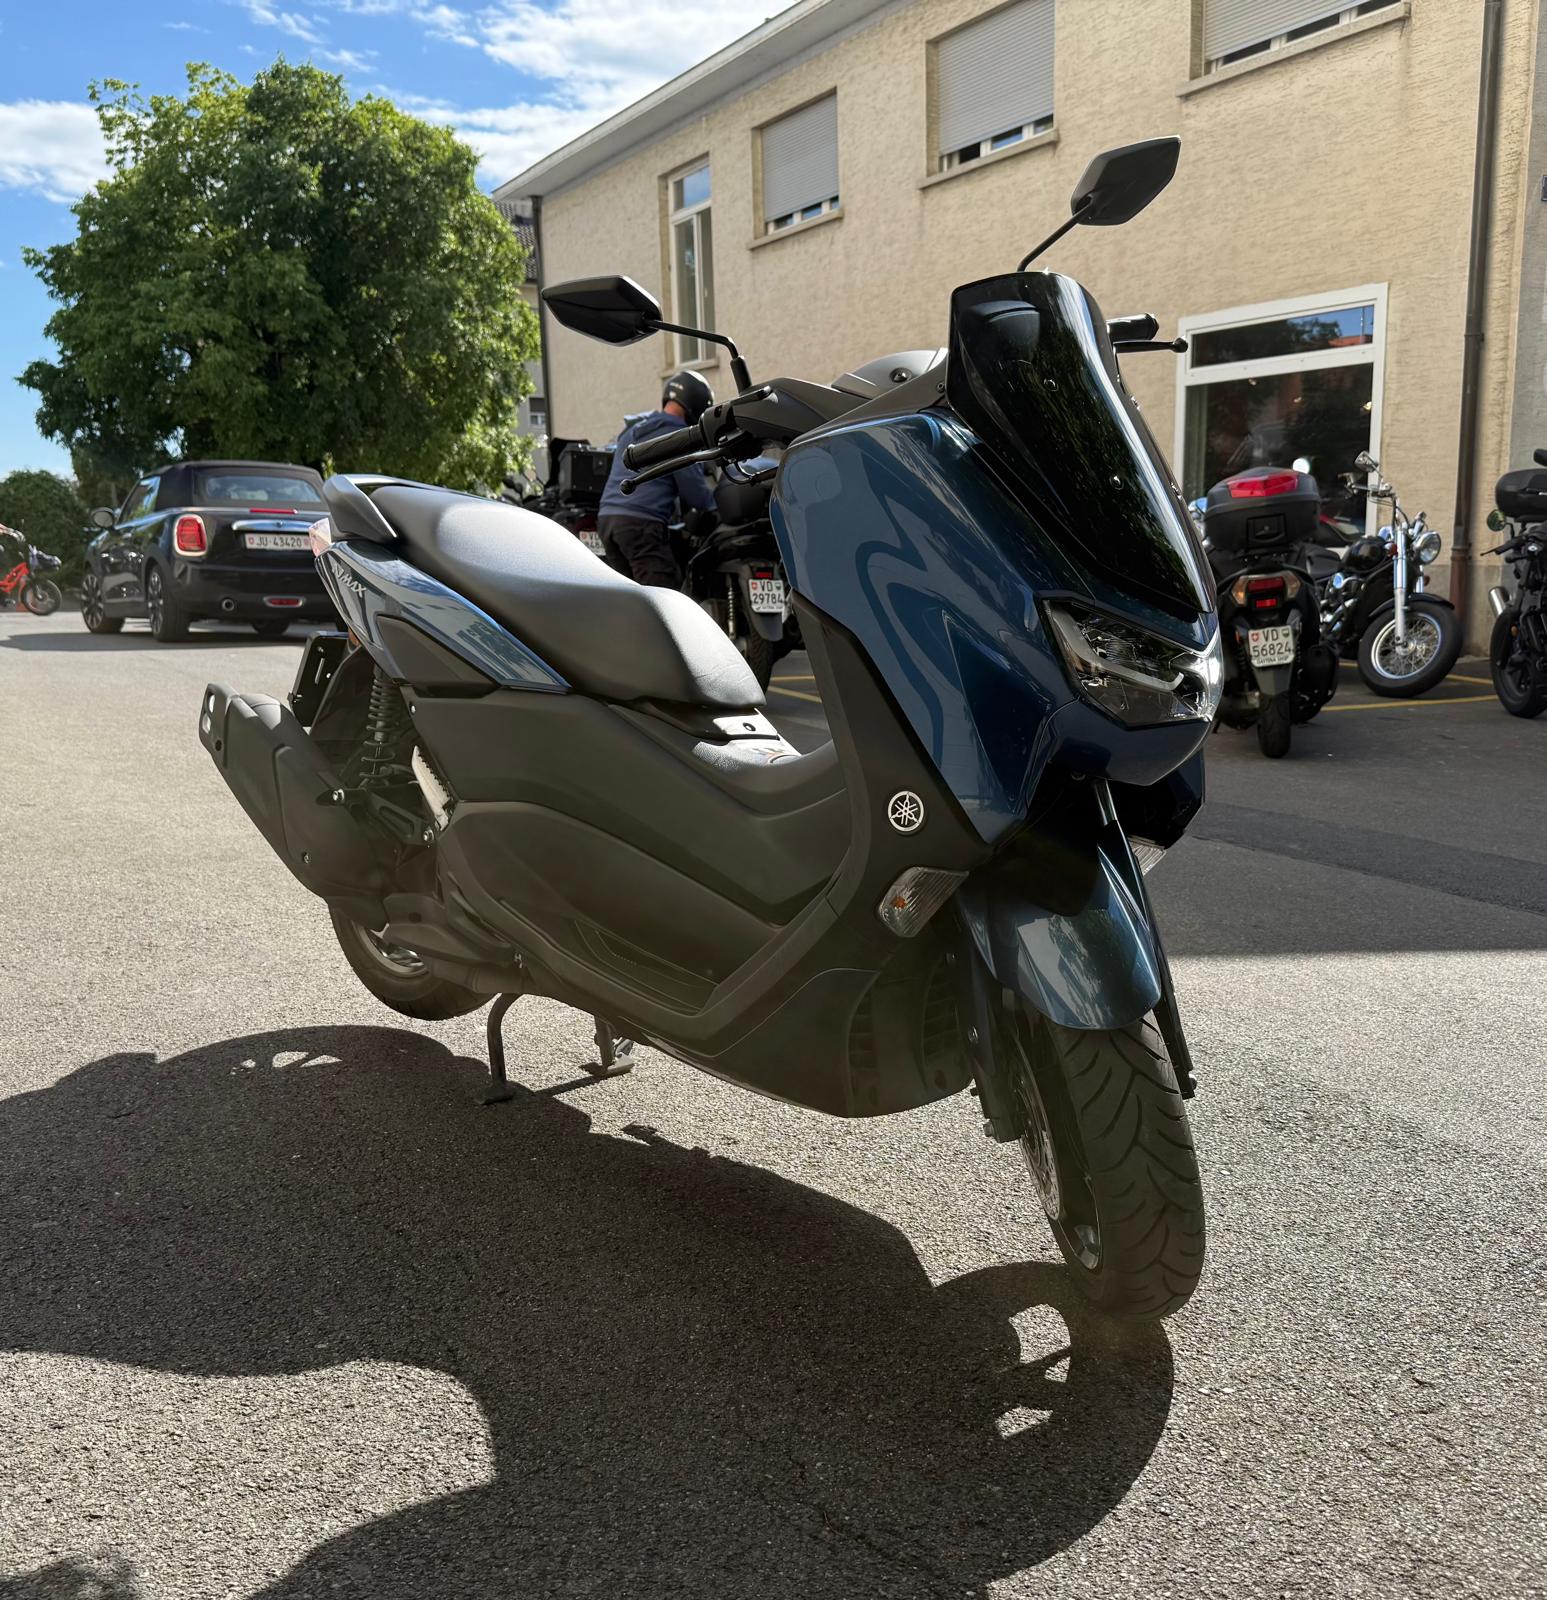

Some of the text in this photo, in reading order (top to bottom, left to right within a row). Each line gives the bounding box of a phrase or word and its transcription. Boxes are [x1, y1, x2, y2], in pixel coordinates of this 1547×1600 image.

[760, 580, 774, 592] VD
[752, 592, 784, 604] 29784
[1262, 628, 1279, 642] VD
[1252, 641, 1291, 658] 56824
